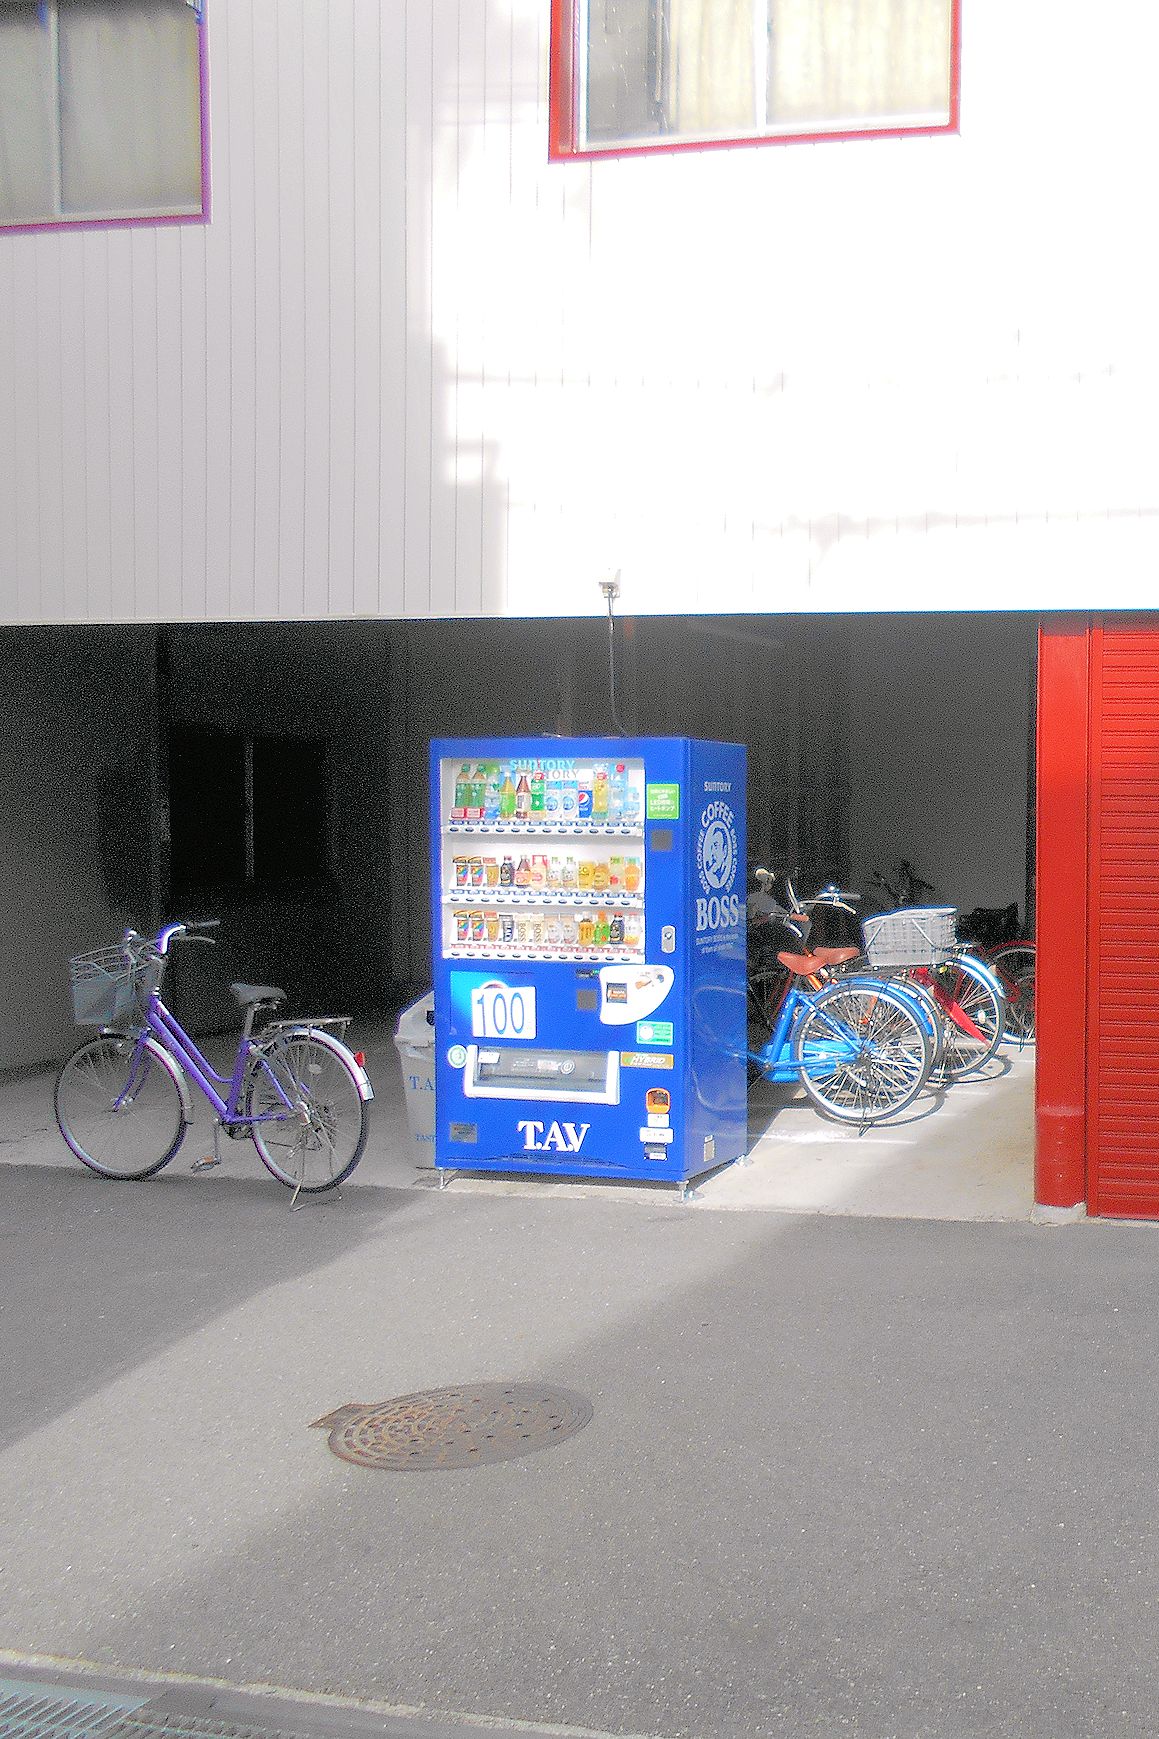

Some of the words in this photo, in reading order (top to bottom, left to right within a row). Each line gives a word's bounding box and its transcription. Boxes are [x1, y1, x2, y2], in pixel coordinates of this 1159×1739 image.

[704, 781, 732, 792] SUNTORY
[701, 801, 735, 829] COFFEE
[696, 894, 740, 931] BOSS
[476, 991, 525, 1036] 100
